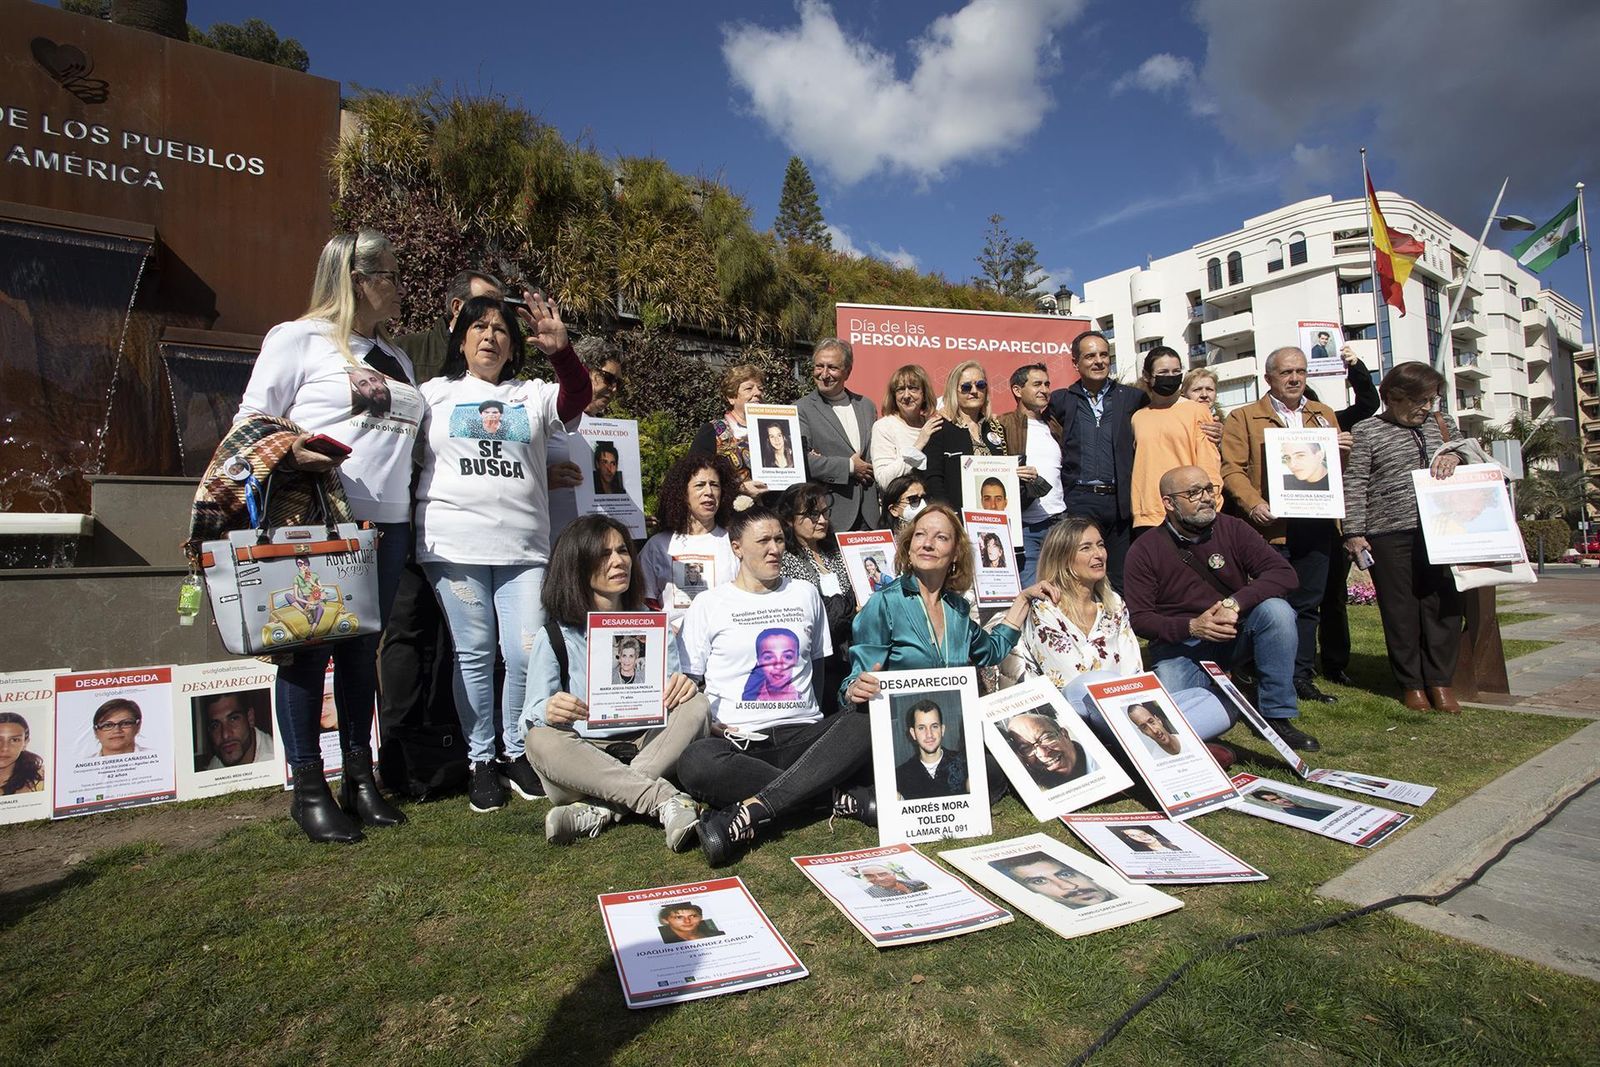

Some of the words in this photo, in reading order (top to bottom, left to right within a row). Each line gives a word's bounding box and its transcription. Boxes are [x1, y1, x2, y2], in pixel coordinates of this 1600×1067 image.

[0, 107, 28, 130] E
[43, 115, 110, 145] LOS
[122, 131, 265, 175] PUEBLOS
[7, 145, 164, 190] AMÉRICA
[850, 318, 876, 333] Día
[880, 320, 900, 334] de
[904, 321, 925, 335] las
[850, 333, 941, 348] PERSONAS
[478, 440, 503, 459] SE
[460, 458, 525, 480] BUSCA
[601, 618, 655, 626] DESAPARECIDA
[76, 674, 159, 688] DESAPARECIDA
[182, 674, 276, 692] DESAPARECIDO
[880, 676, 968, 690] DESAPARECIDO
[1103, 682, 1144, 695] DESAPARECIDO
[735, 702, 743, 710] LA
[744, 702, 776, 710] SEGUIMOS
[901, 802, 940, 815] ANDRÉS
[942, 800, 970, 811] MORA
[917, 814, 955, 826] TOLEDO
[906, 827, 940, 838] LLAMAR
[942, 826, 954, 834] AL
[955, 824, 968, 832] 091
[808, 847, 900, 865] DESAPARECIDO
[627, 885, 708, 901] DESAPARECIDO
